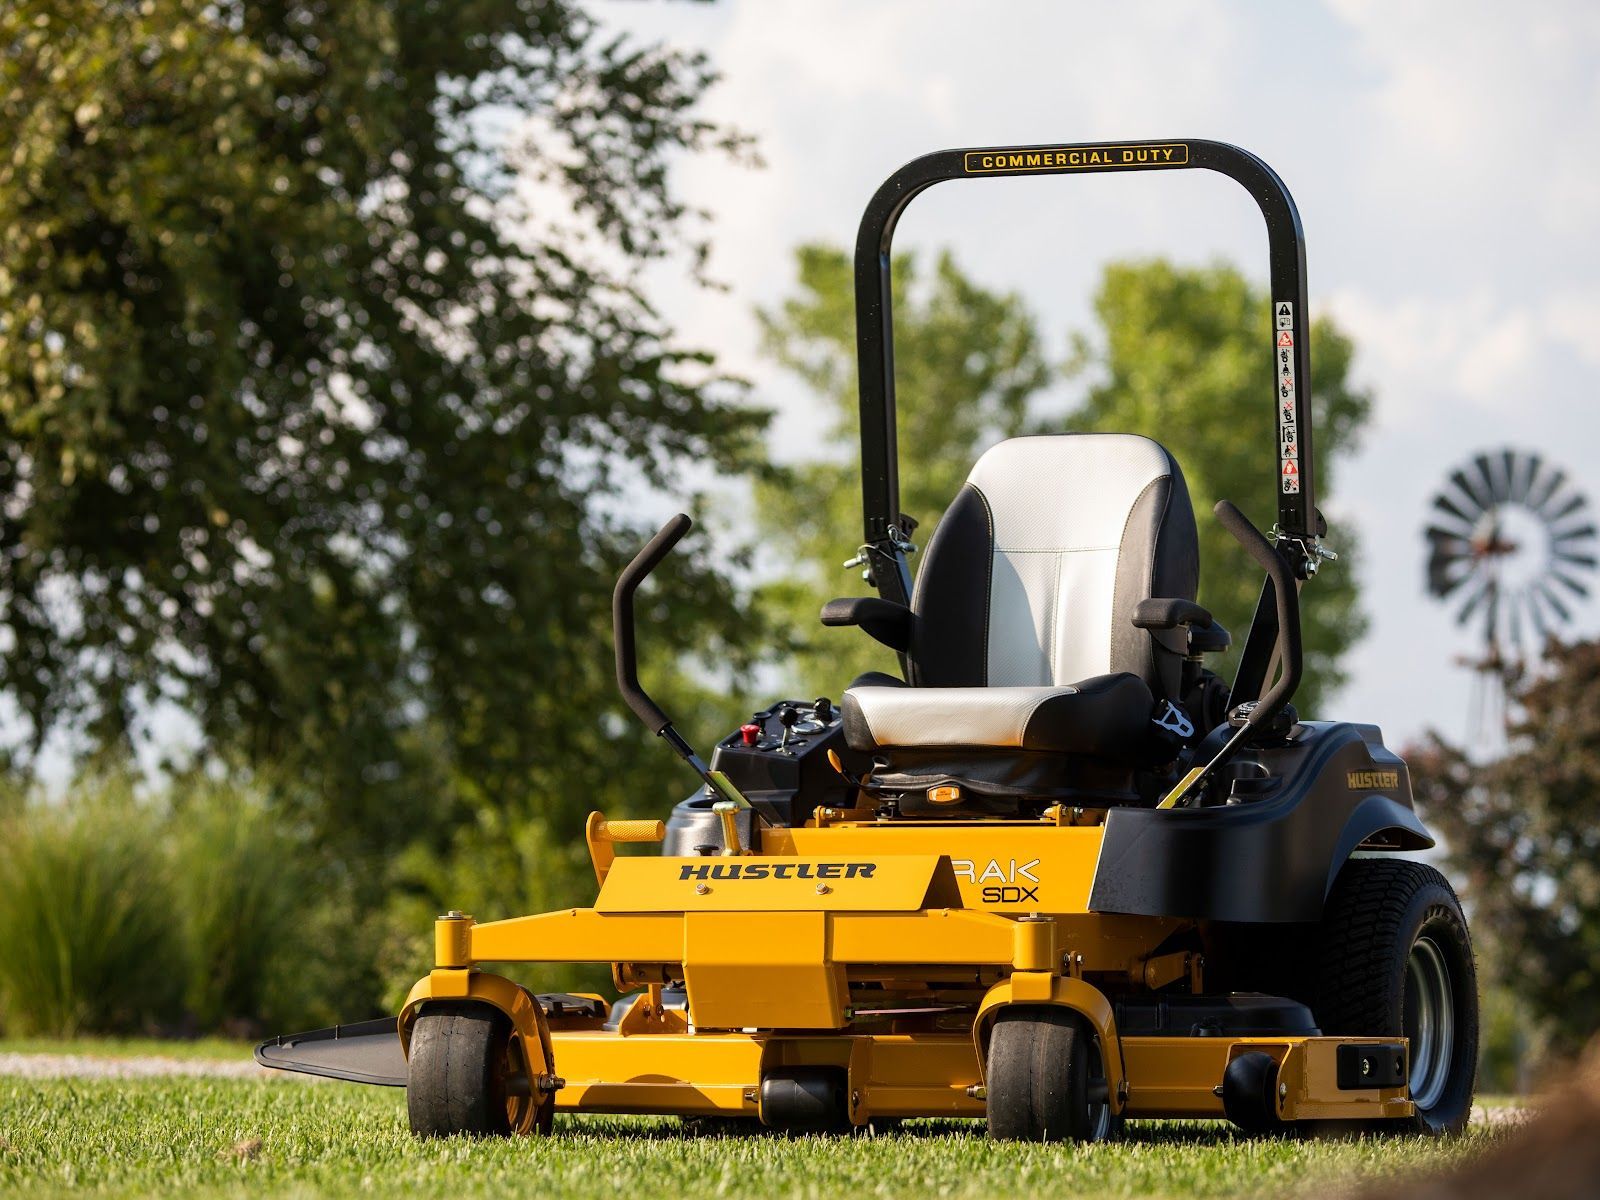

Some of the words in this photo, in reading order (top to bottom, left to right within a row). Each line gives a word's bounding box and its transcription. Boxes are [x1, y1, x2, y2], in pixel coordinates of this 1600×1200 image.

[982, 151, 1113, 168] COMMERCIAL
[1122, 149, 1173, 162] DUTY
[1346, 771, 1399, 789] HUSTLER
[679, 863, 877, 881] HUSTLER
[982, 886, 1039, 903] SDX
